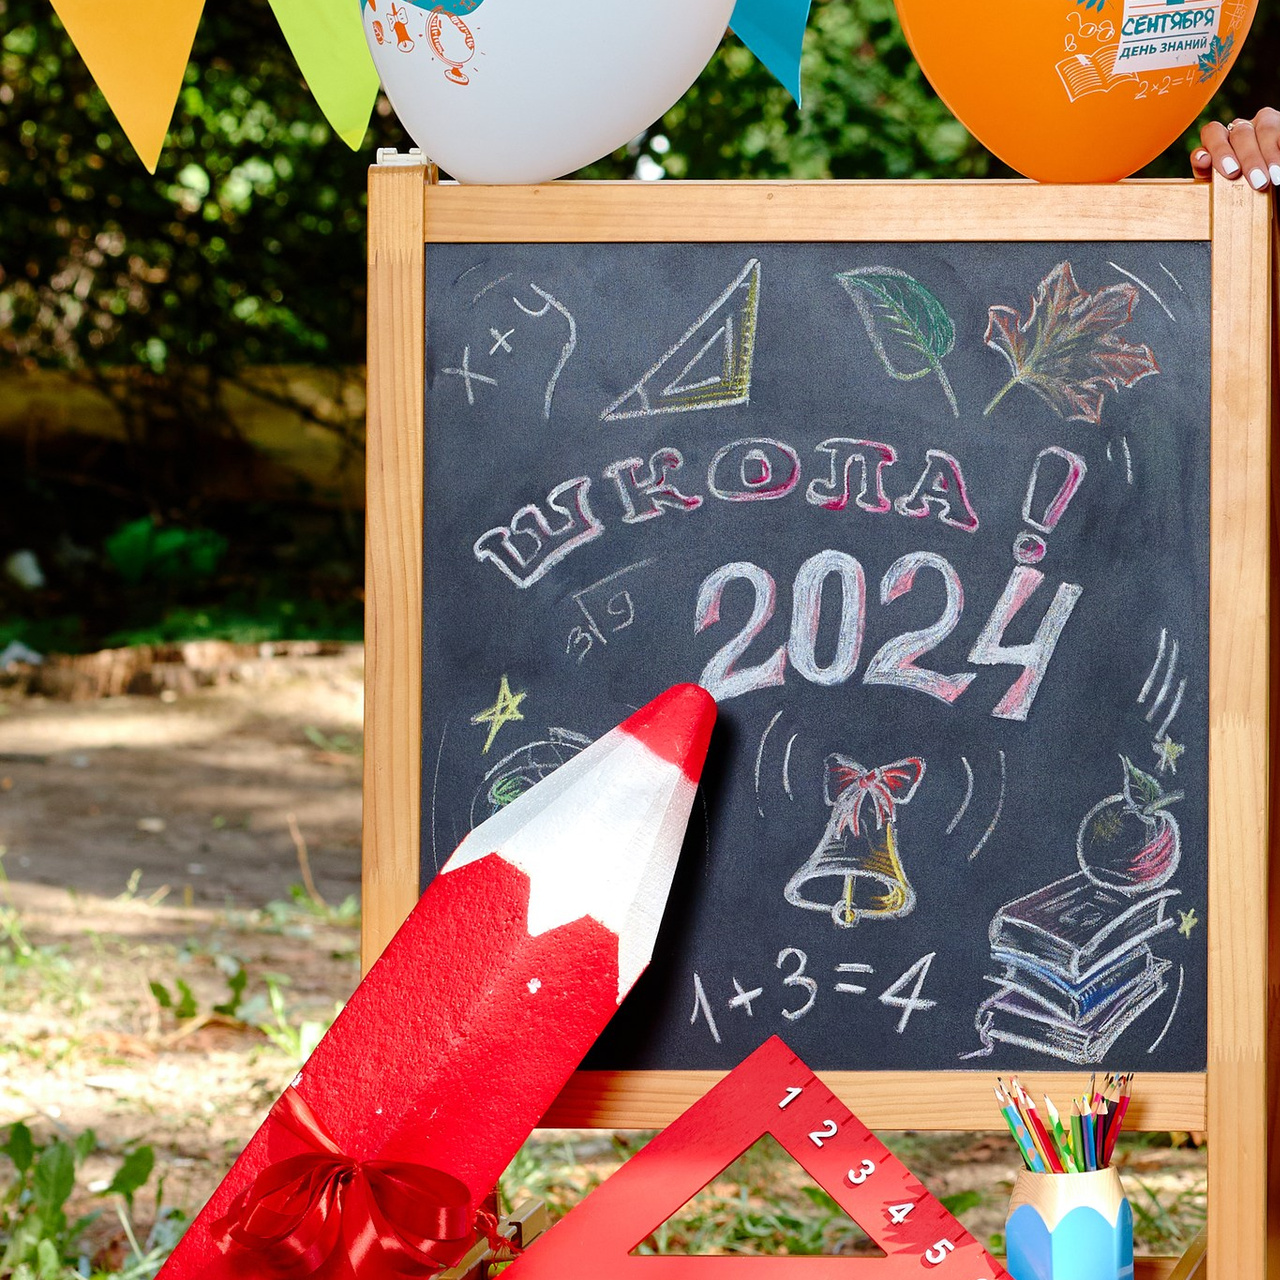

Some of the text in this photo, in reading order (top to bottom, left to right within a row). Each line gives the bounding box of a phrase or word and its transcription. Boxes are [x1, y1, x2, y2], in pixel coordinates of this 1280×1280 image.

[1118, 35, 1208, 60] ДЕНЬ ЗНАНИЙ
[1120, 7, 1216, 37] СЕНТЯБРЯ
[693, 548, 1084, 722] 2024
[777, 1085, 803, 1111] 1
[808, 1119, 838, 1148] 2
[847, 1159, 876, 1186] 3
[886, 1202, 917, 1227] 4
[925, 1237, 955, 1266] 5
